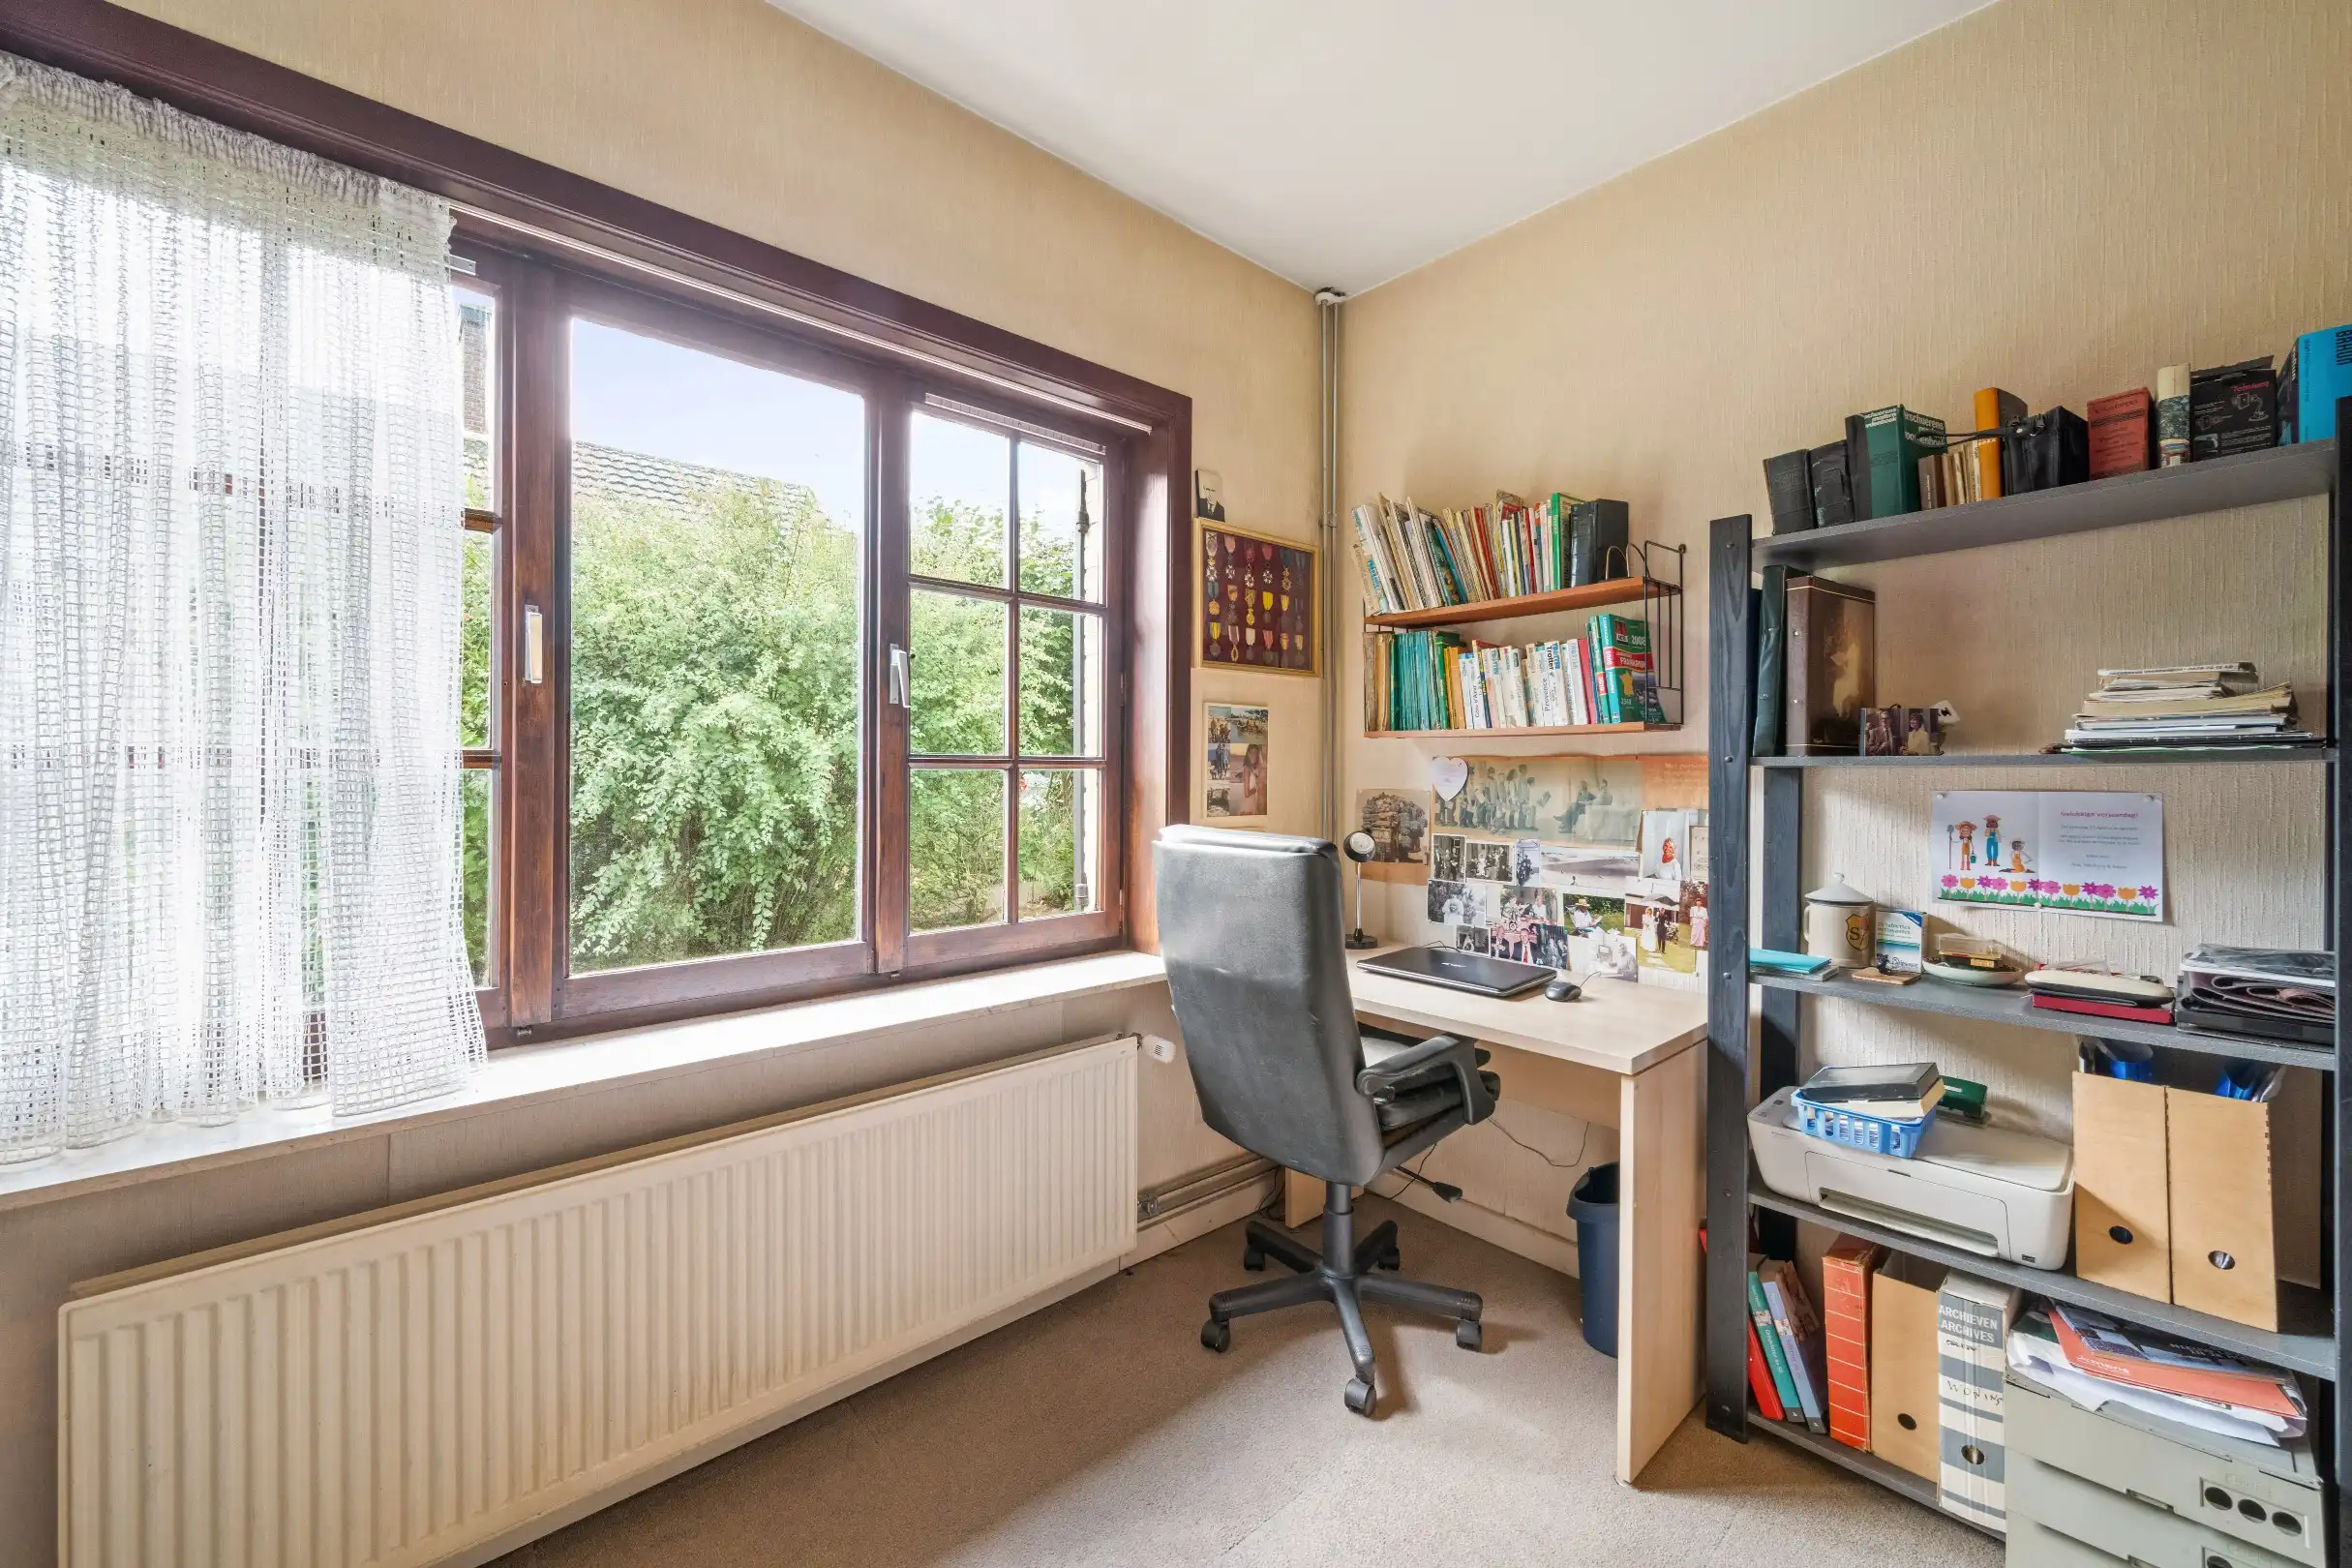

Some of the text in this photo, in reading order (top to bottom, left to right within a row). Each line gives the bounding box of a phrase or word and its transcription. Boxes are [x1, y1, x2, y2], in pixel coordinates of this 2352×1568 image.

[1864, 407, 1897, 420] schuerens
[1543, 678, 1552, 712] Provence
[1938, 1304, 1998, 1331] ARCHIEVEN
[1941, 1318, 1995, 1343] ARCHIVES
